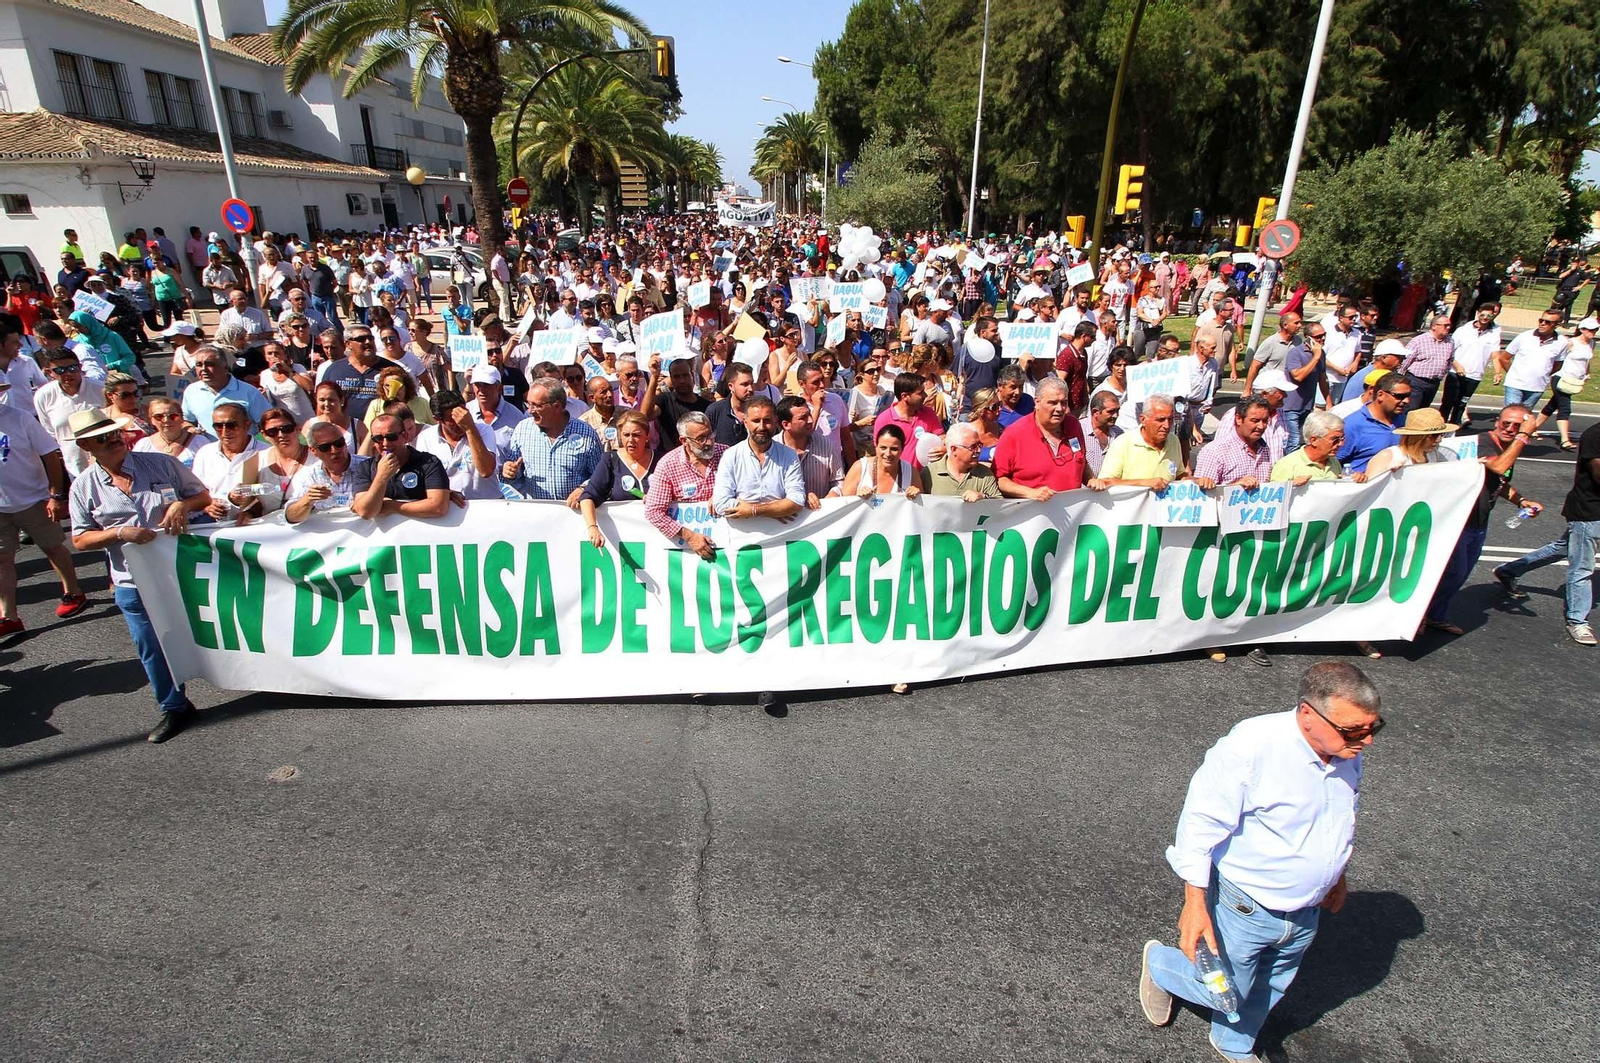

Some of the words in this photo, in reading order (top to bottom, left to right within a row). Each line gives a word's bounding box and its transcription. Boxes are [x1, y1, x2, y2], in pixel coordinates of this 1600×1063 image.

[1239, 506, 1277, 525] YA!!
[176, 533, 267, 653] EN
[286, 540, 561, 658] DEFENSA
[580, 541, 648, 654] DE
[667, 543, 768, 654] LOS
[785, 515, 1060, 648] REGADÍOS
[1068, 524, 1162, 625] DEL
[1181, 501, 1432, 622] CONDADO
